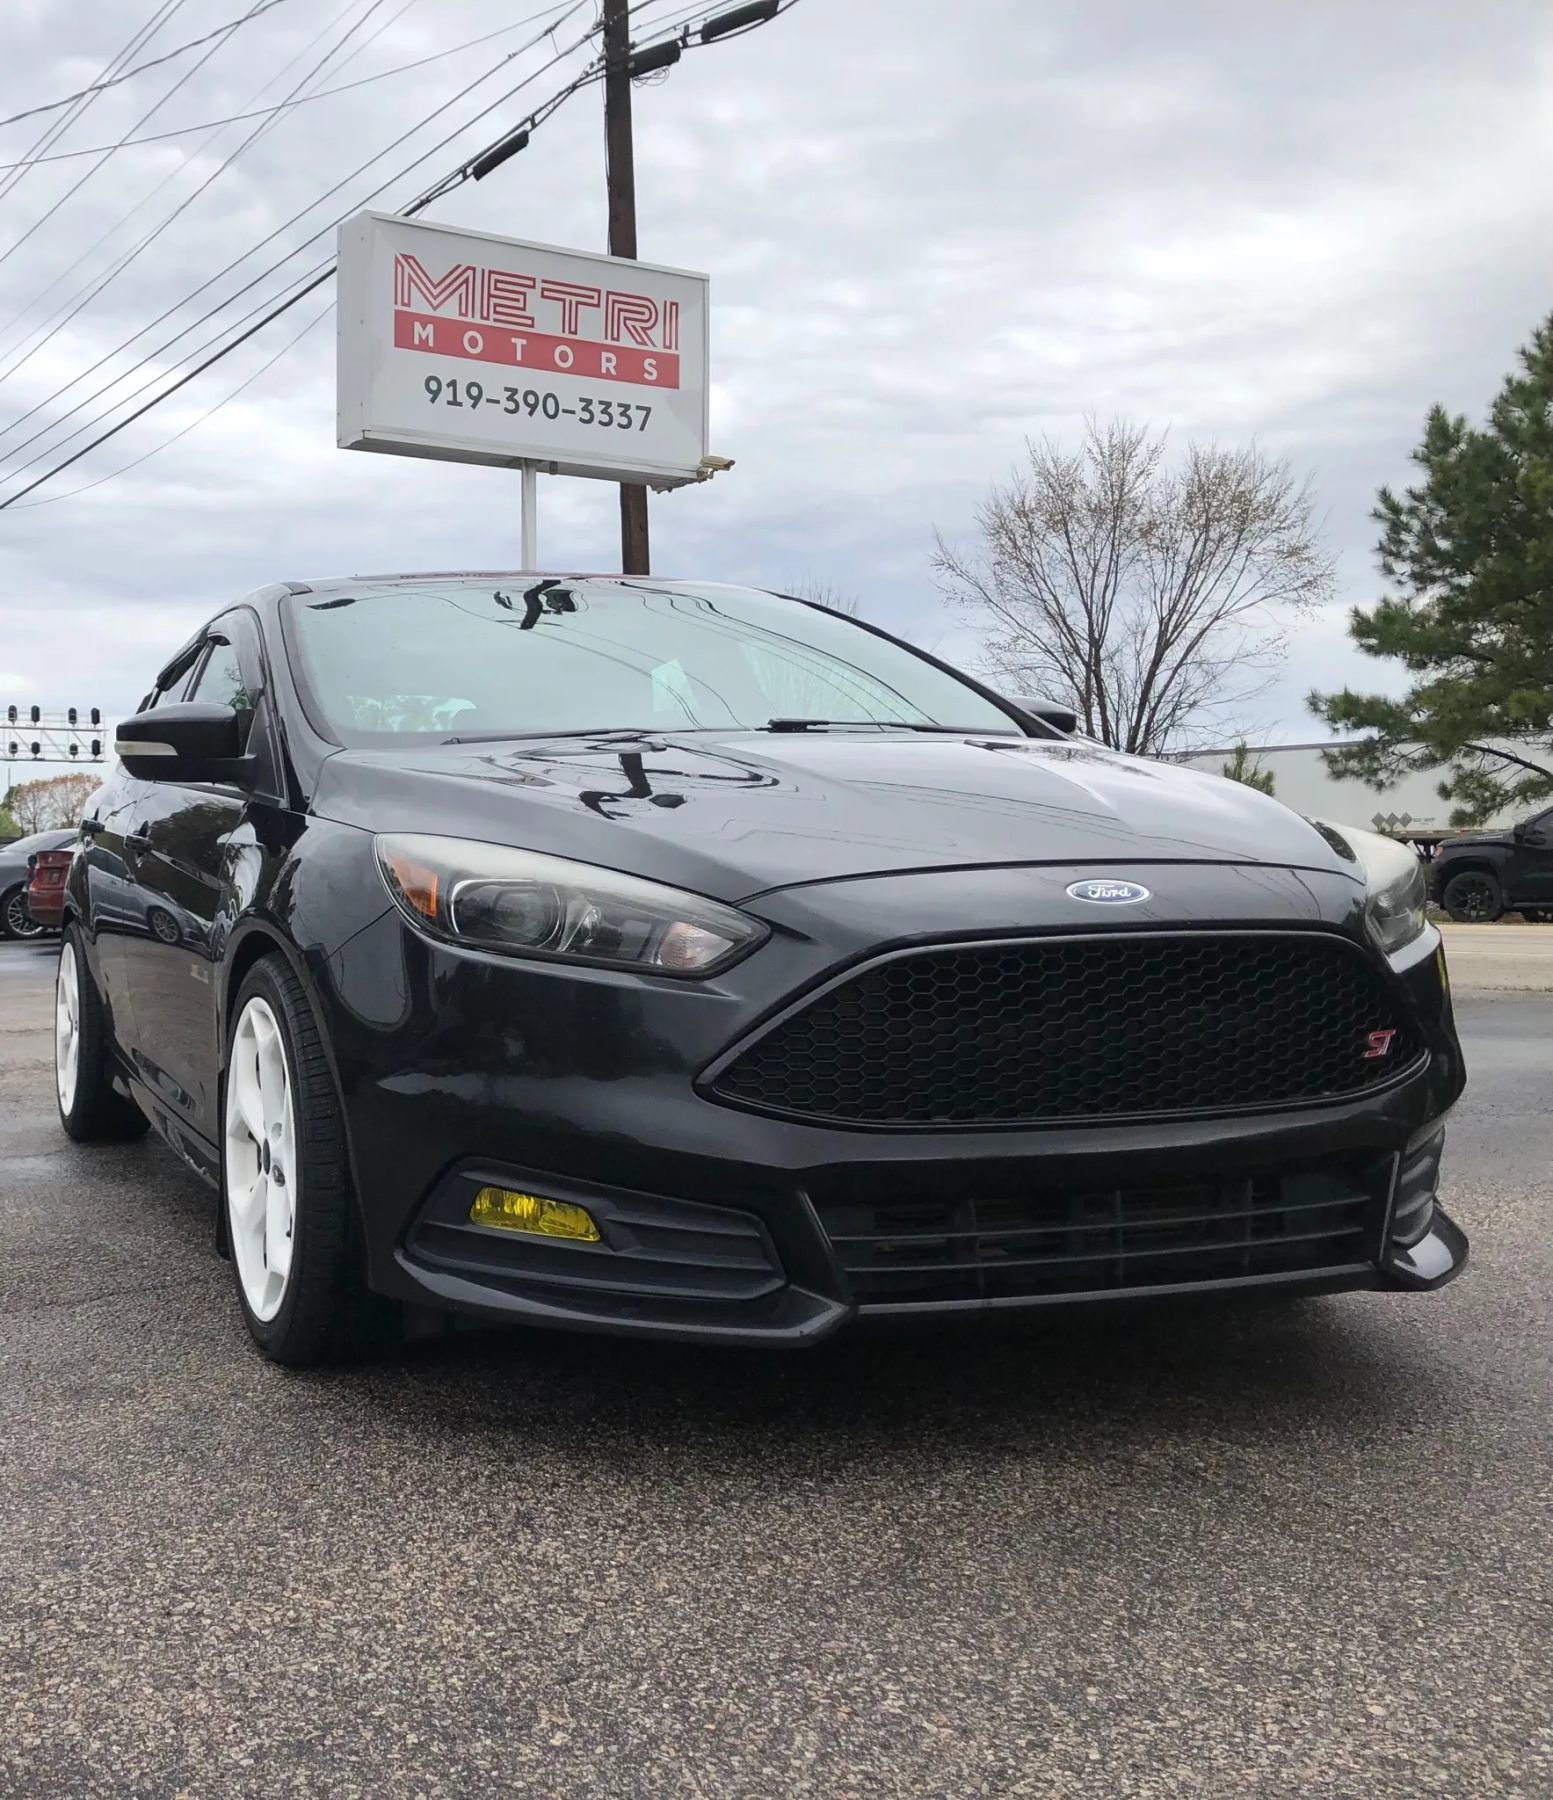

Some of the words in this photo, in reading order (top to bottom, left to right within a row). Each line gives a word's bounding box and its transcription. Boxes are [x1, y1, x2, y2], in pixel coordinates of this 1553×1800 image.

[394, 252, 680, 350] METRI
[413, 321, 658, 382] MOTORS
[424, 375, 652, 432] 919-390-3337
[1088, 884, 1131, 898] Ford
